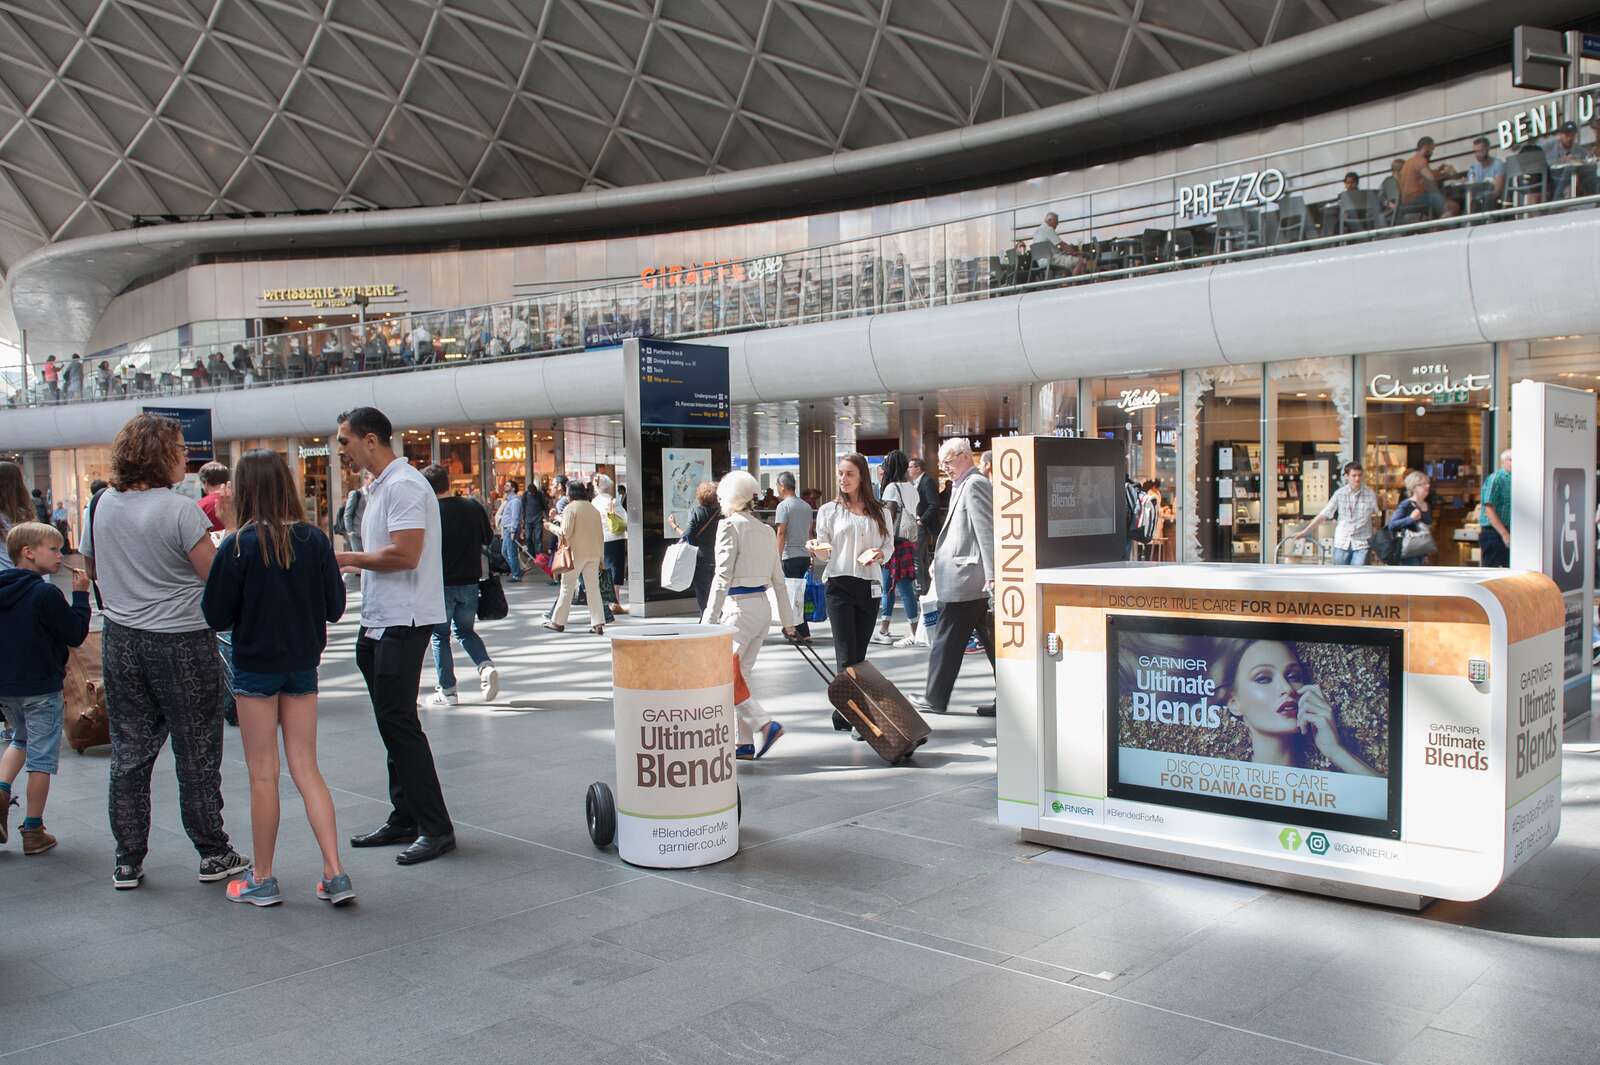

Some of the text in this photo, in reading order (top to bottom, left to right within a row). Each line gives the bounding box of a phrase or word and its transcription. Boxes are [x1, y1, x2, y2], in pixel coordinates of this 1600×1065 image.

[1180, 168, 1285, 218] PREZZO
[641, 256, 746, 289] GIRAFFE
[263, 287, 336, 300] PATISSERIE
[1412, 364, 1449, 375] HOTEL
[1371, 374, 1491, 398] Chocolat
[1117, 389, 1160, 412] Kiehl's
[1000, 448, 1025, 649] GARNIER
[1108, 594, 1400, 619] DISCOVER TRUE CARE FOR DAMAGED HAIR
[1138, 655, 1207, 671] GARNIER
[1136, 669, 1216, 696] Ultimate
[1520, 662, 1552, 690] GARNIER
[642, 704, 724, 722] GARNIER
[1132, 691, 1221, 728] Blends
[1518, 687, 1556, 728] Ultimate
[640, 722, 729, 751] Ultimate
[1430, 723, 1480, 734] GARNIER
[1428, 732, 1486, 751] Ultimate
[1515, 716, 1557, 780] Blends
[636, 746, 733, 788] Blends
[1425, 746, 1489, 771] Blends
[1166, 758, 1329, 791] DISCOVER TRUE CARE
[1160, 773, 1337, 808] FOR DAMAGED HAIR
[1051, 800, 1164, 824] GARNIER #BlendedForMe
[652, 820, 729, 838] #BlendedForMe
[658, 834, 728, 855] garnier.co.uk
